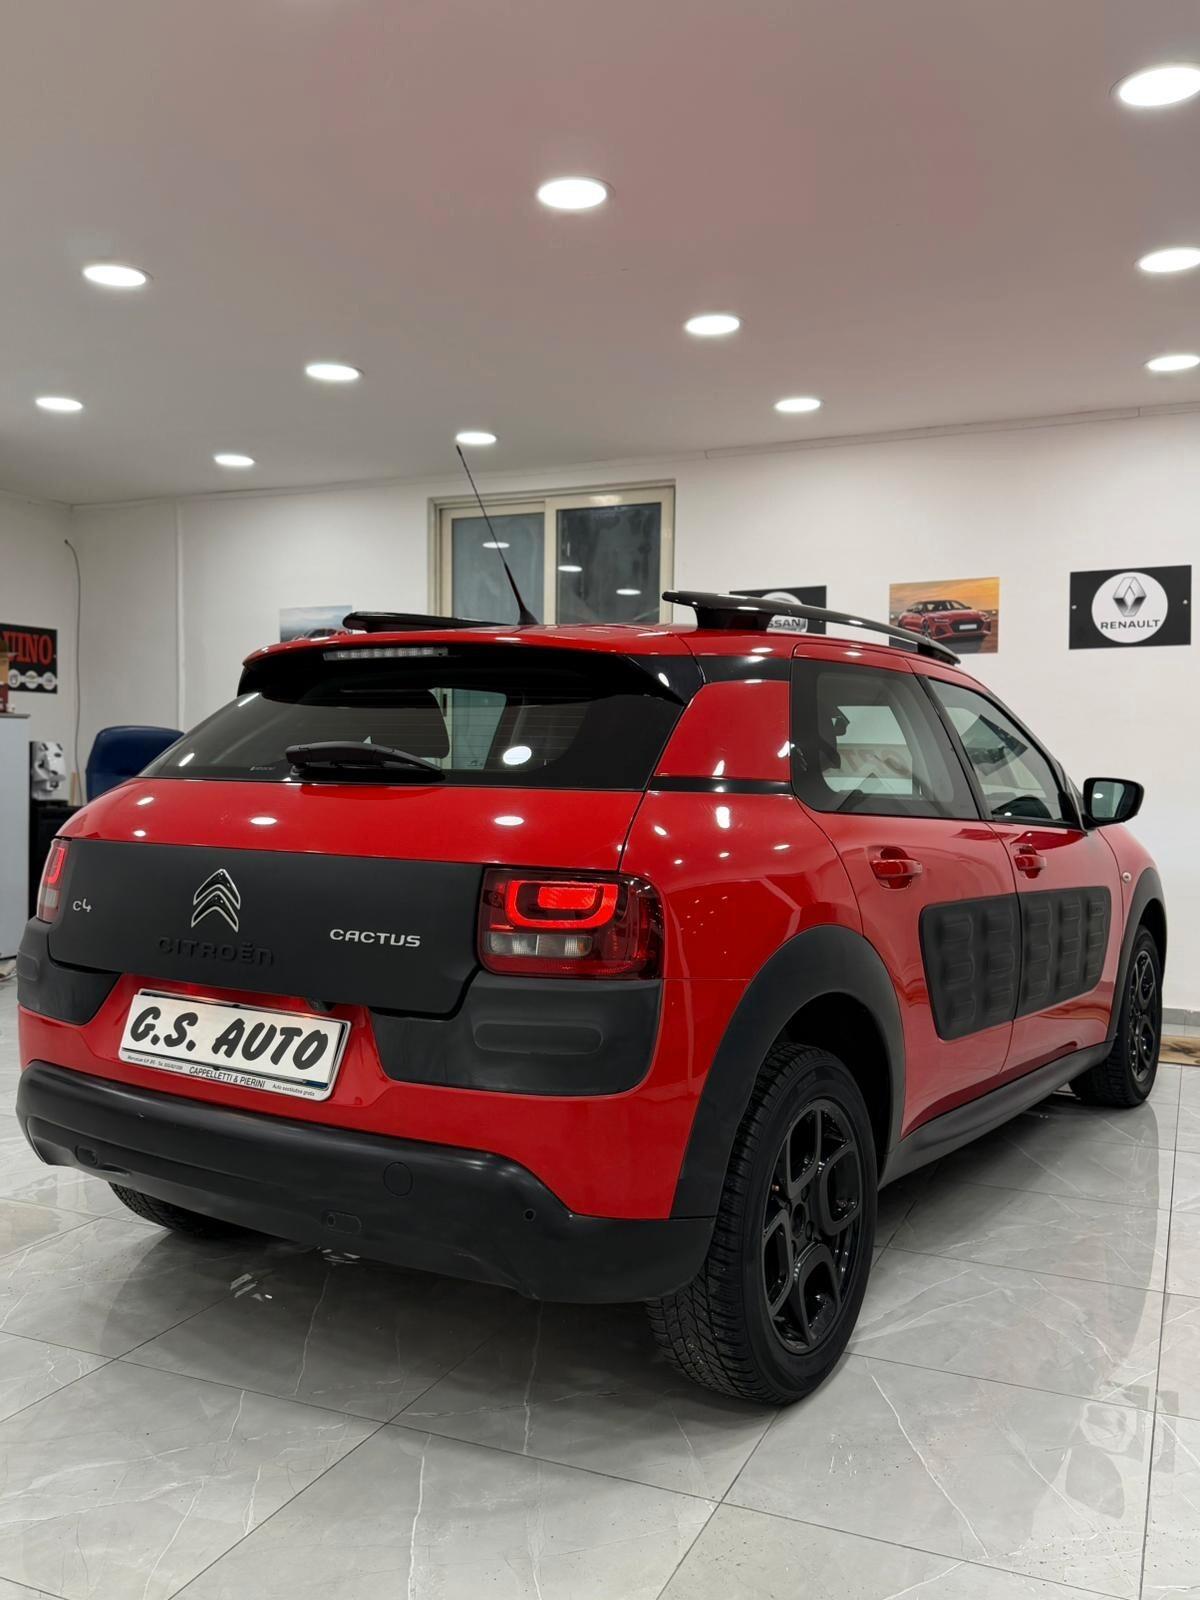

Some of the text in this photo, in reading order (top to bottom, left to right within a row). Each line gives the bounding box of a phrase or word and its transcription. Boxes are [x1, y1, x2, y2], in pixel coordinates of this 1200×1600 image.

[1100, 619, 1160, 630] RENAULT
[329, 928, 421, 947] CACTUS
[130, 1006, 329, 1071] G.S. AUTO
[189, 1066, 232, 1082] CAPPELLETTI
[239, 1076, 266, 1089] PIERINI
